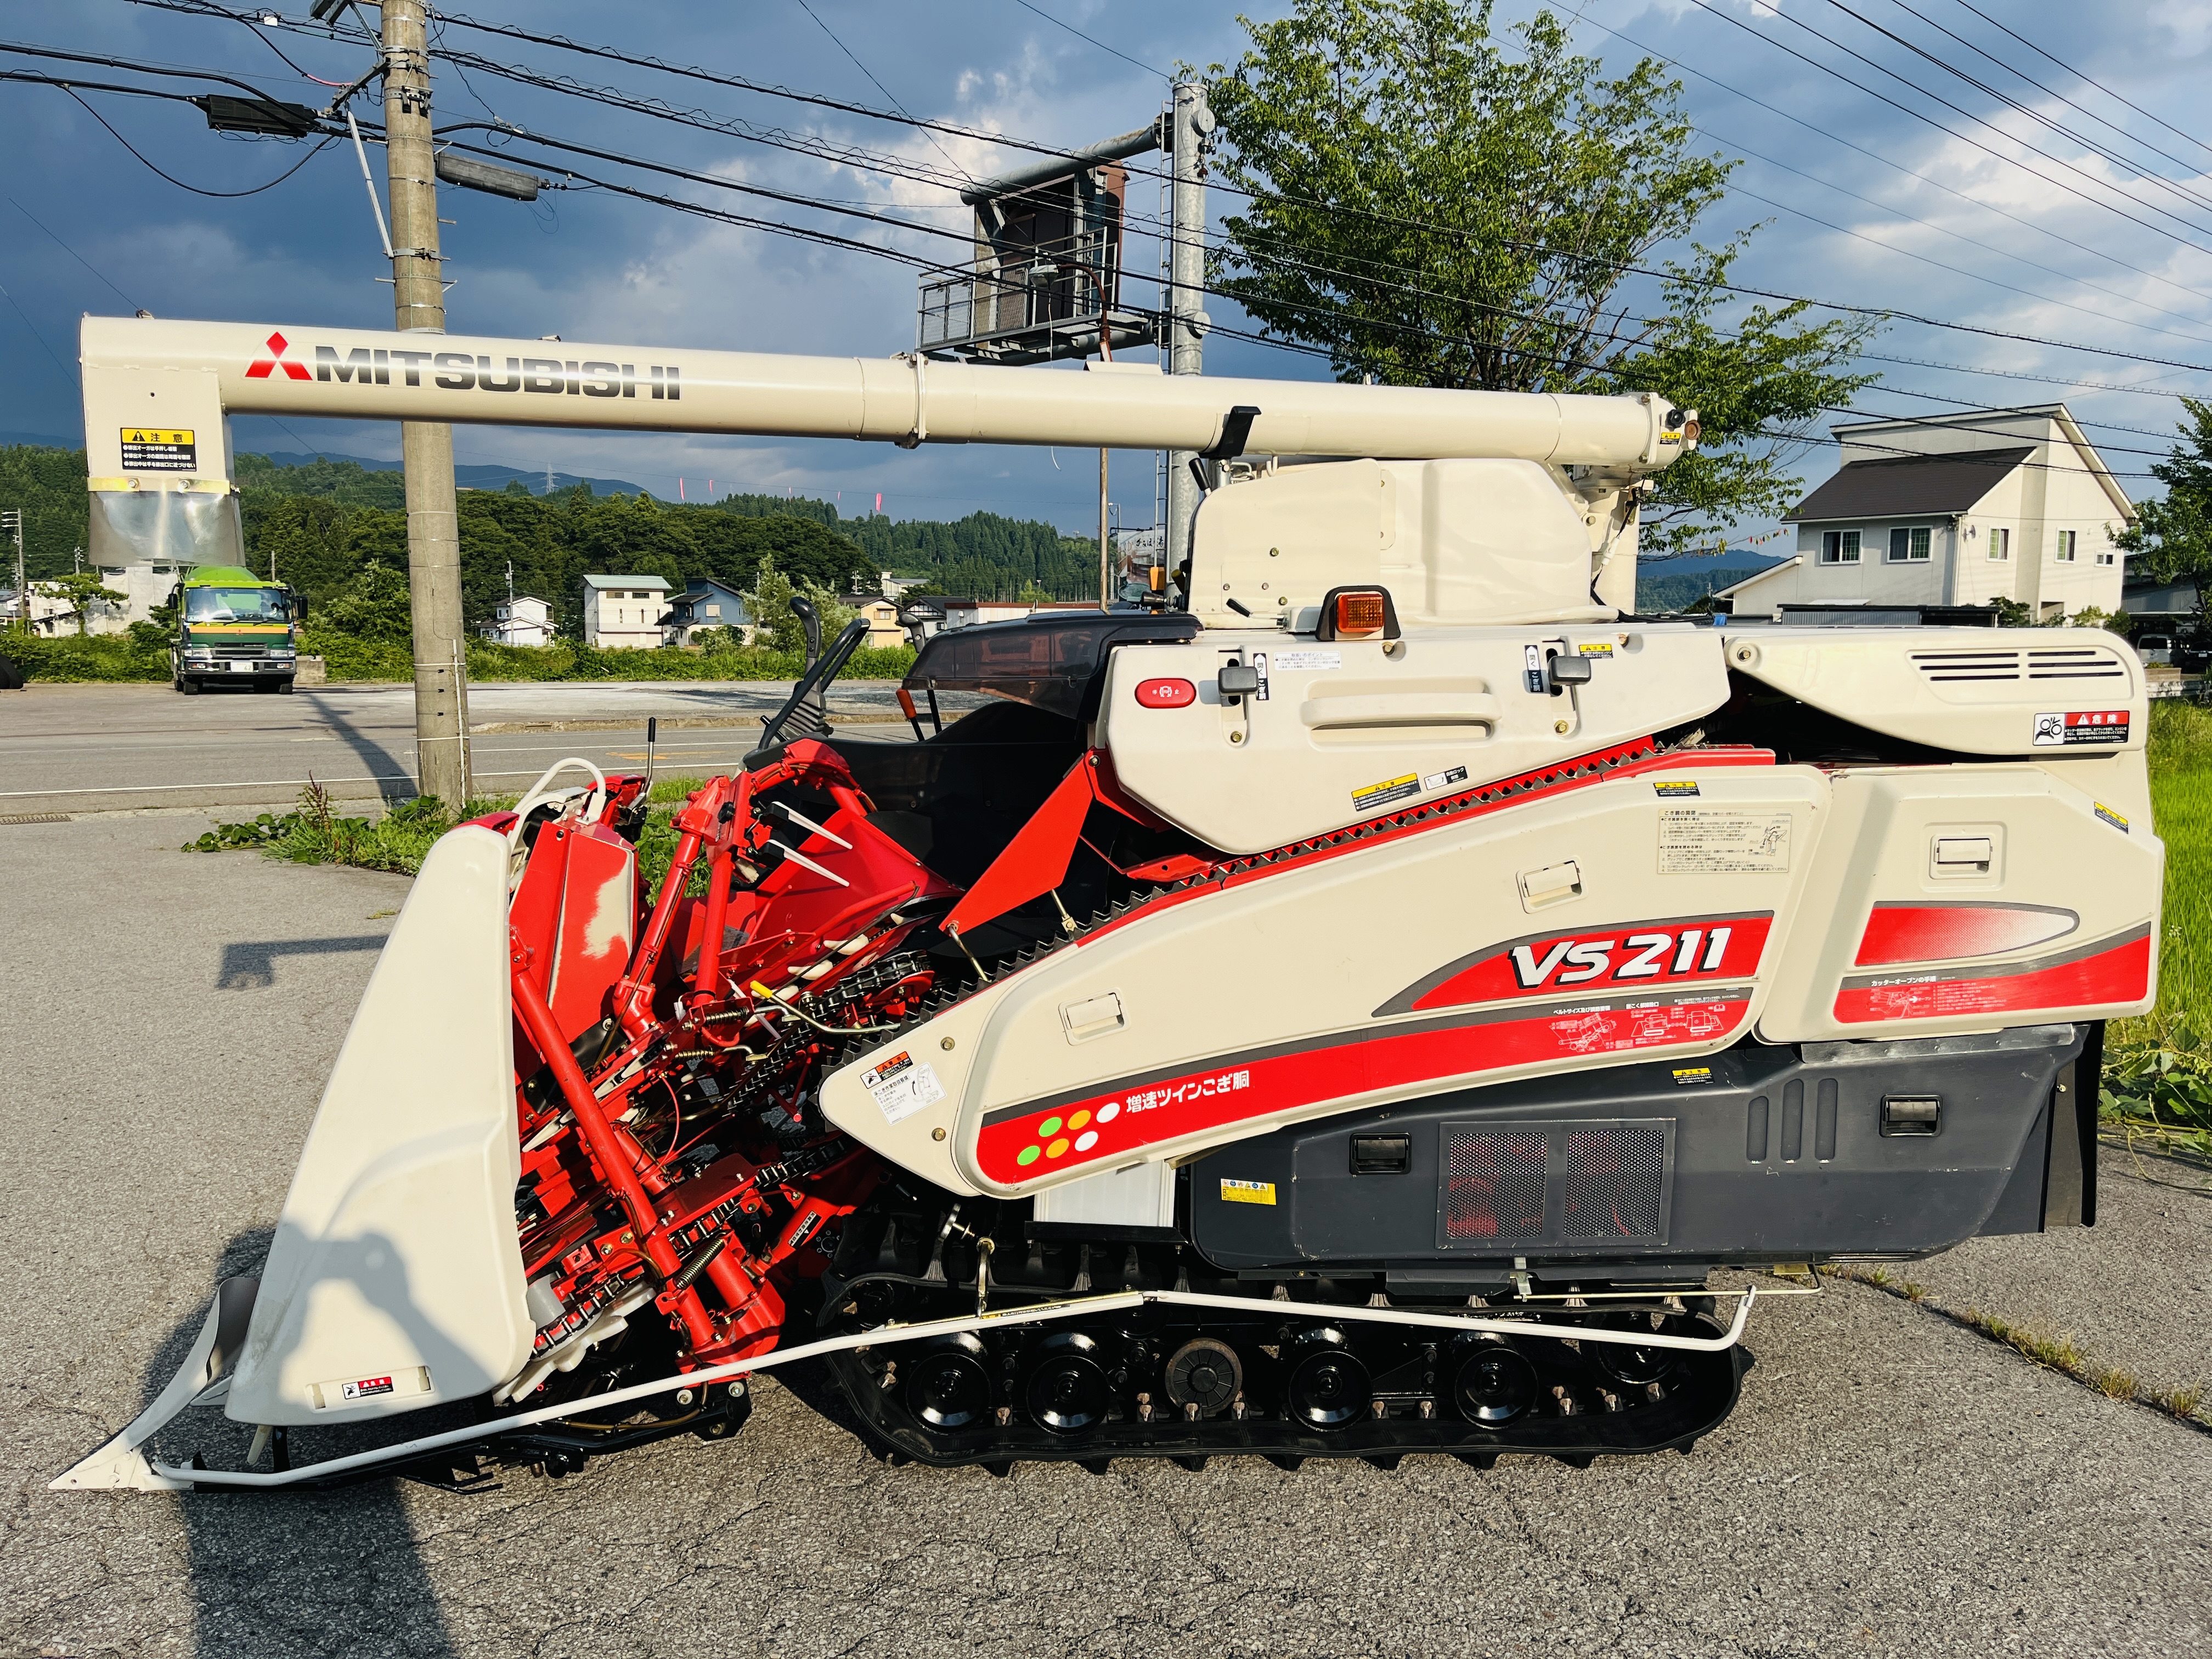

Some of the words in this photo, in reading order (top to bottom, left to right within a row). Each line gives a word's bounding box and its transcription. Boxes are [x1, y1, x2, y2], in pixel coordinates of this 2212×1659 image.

[315, 345, 681, 400] MITSUBISHI
[1508, 927, 1732, 990] VS211
[1126, 1070, 1250, 1114] 増速ツインこぎ胴
